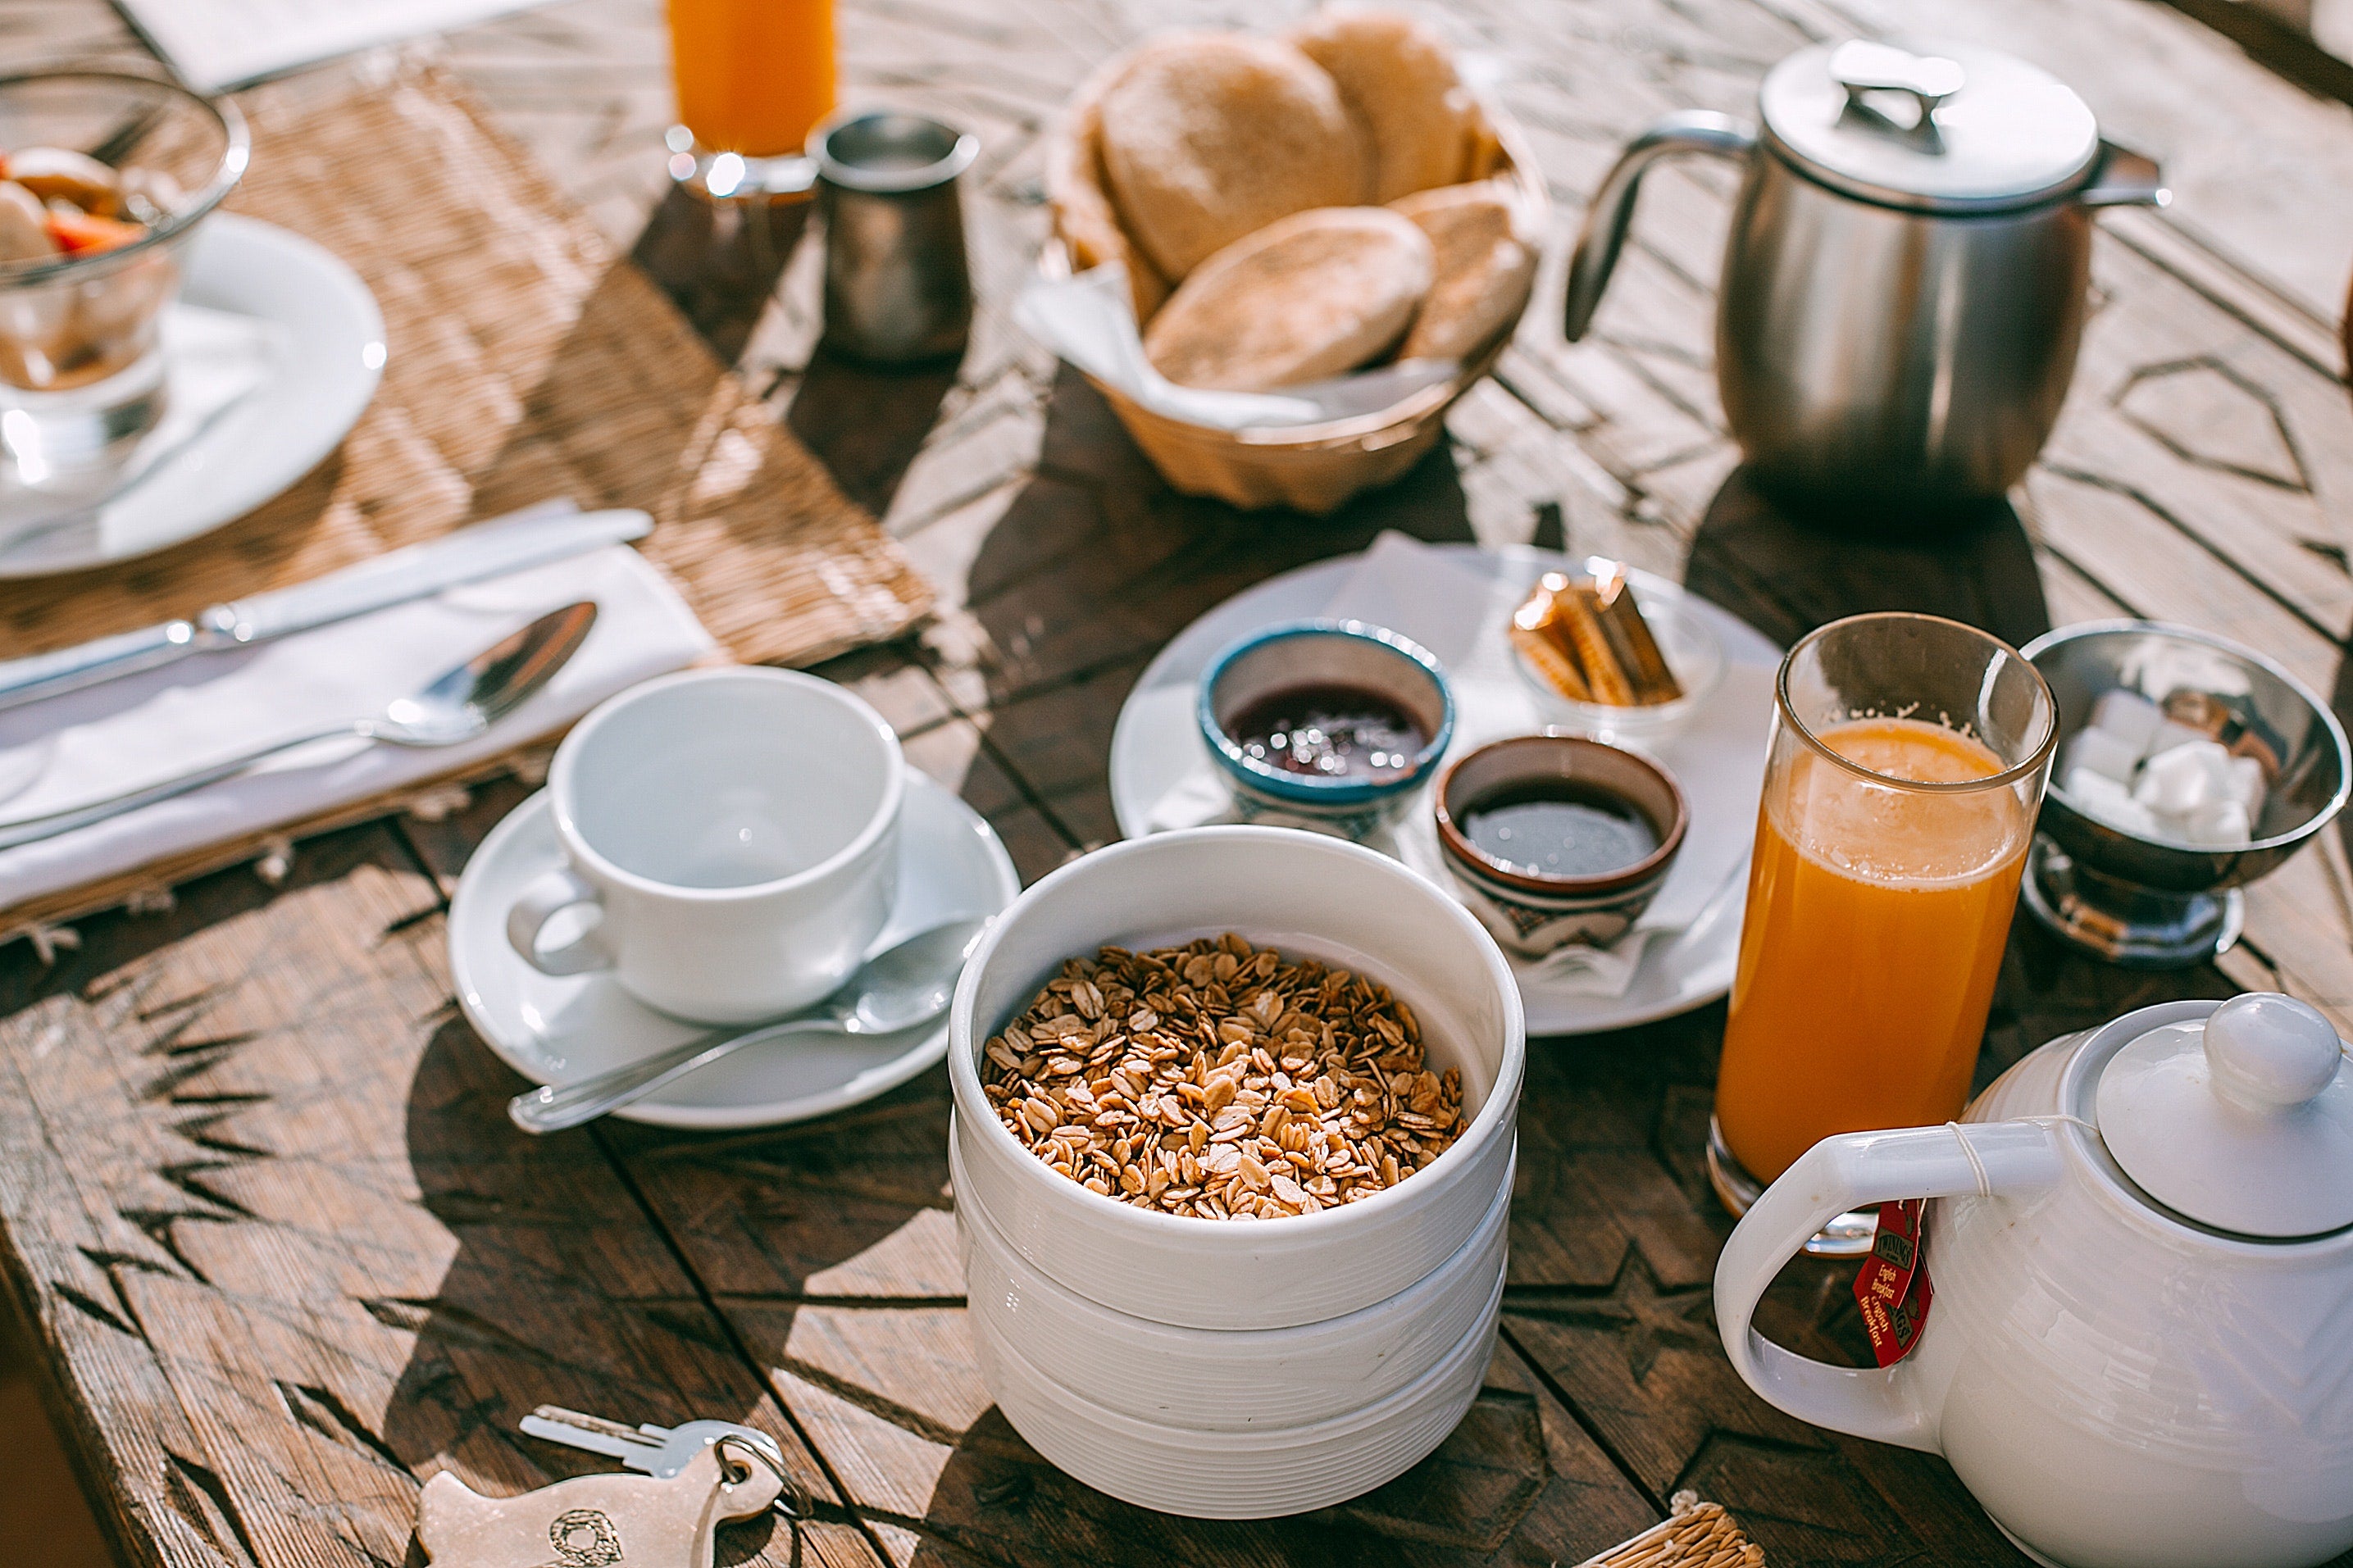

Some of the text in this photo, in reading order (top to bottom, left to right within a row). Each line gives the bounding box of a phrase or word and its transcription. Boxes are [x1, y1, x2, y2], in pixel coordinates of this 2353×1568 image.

[1878, 1264, 1896, 1282] English
[1871, 1278, 1895, 1299] Breakfast
[1860, 1295, 1882, 1348] Breakfast
